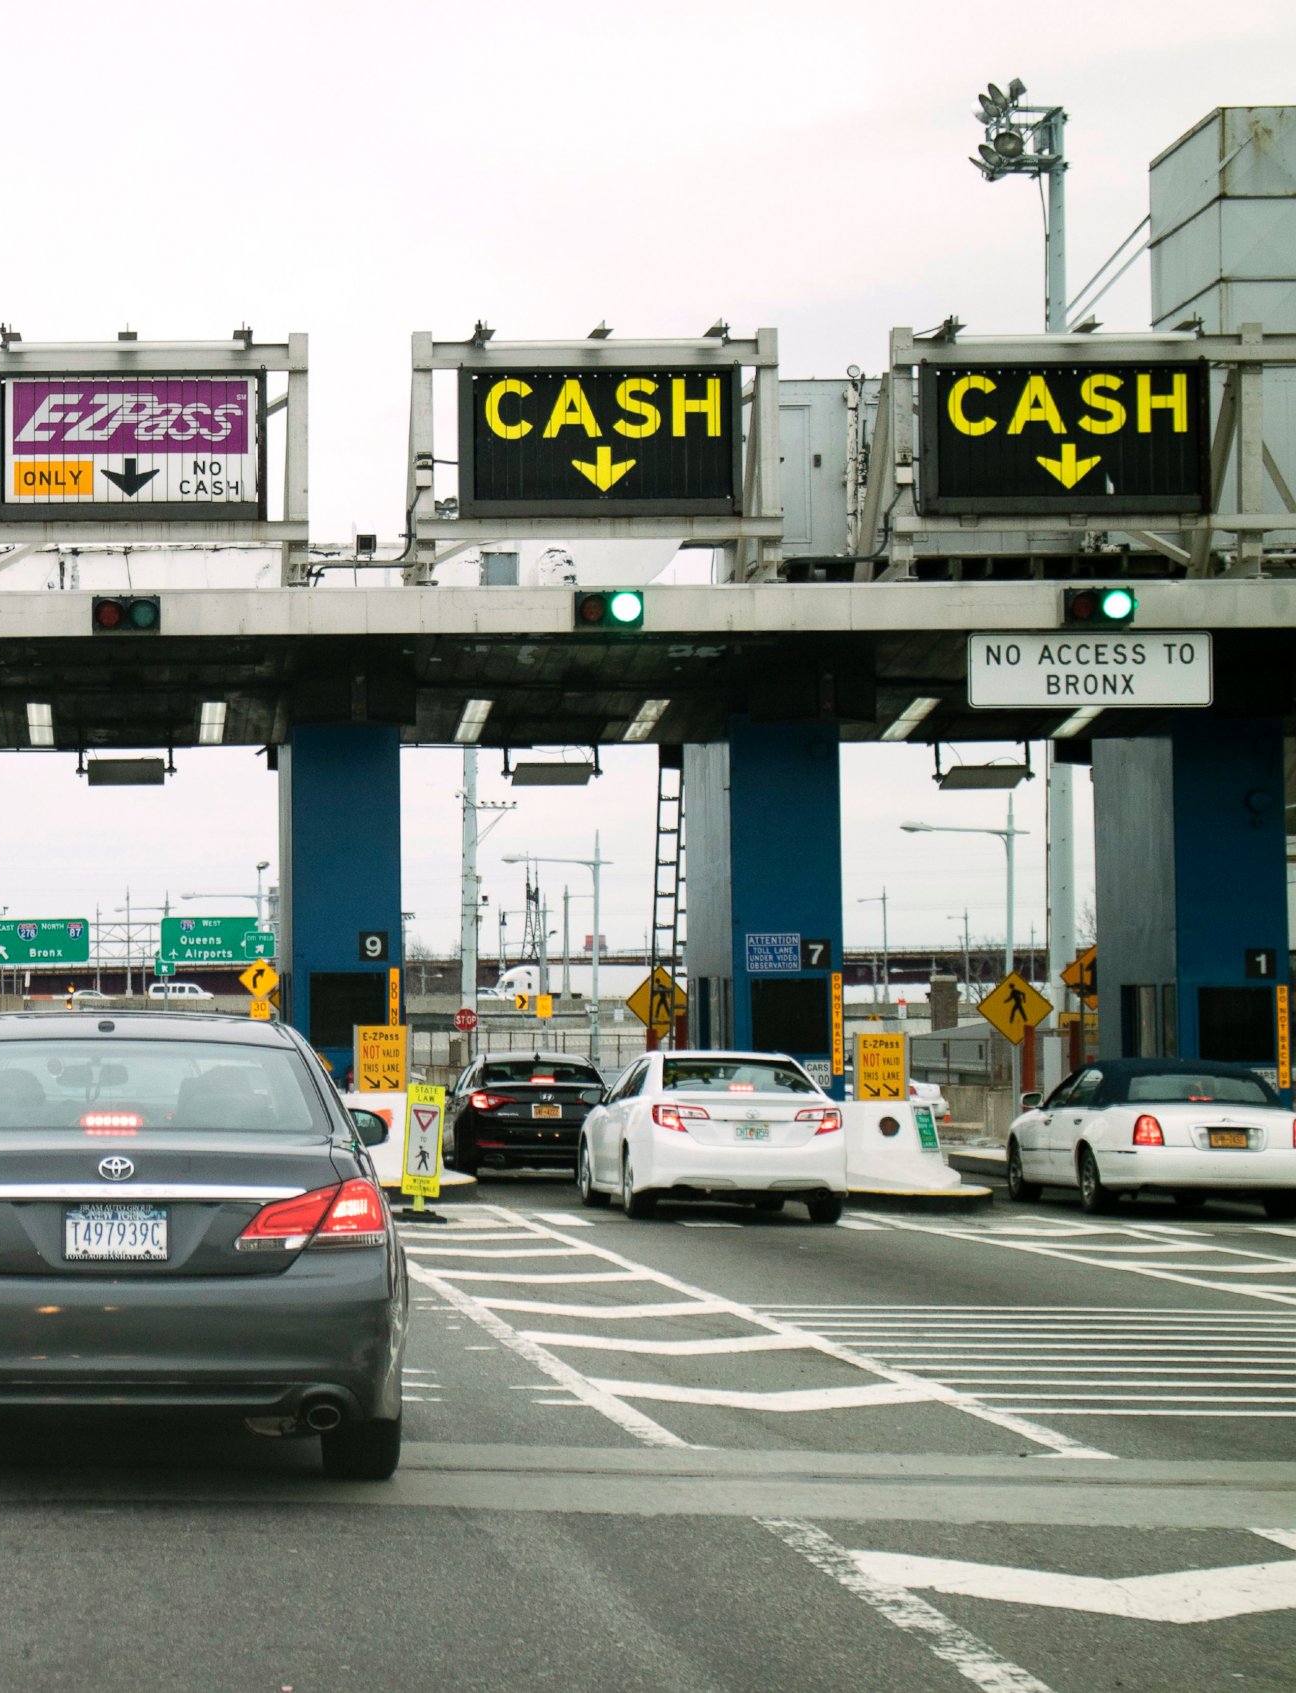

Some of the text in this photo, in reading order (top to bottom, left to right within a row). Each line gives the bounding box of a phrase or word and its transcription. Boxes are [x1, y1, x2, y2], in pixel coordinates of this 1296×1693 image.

[485, 377, 721, 440] CASH
[947, 373, 1188, 437] CASH
[14, 393, 243, 442] E-ZPass
[193, 460, 222, 476] NO
[23, 470, 82, 486] ONLY
[179, 480, 239, 495] CASH
[986, 642, 1196, 667] NO ACCESS TO
[1046, 673, 1135, 696] BRONX
[20, 928, 36, 938] 278
[69, 928, 81, 937] 87
[180, 935, 222, 945] Queens
[748, 936, 798, 945] ATTENTION
[29, 948, 63, 957] Bronx
[365, 936, 381, 957] 9
[774, 946, 793, 954] LANE
[185, 948, 233, 960] Airports
[808, 944, 824, 965] 7
[1255, 953, 1267, 974] 1
[834, 975, 840, 990] DO
[391, 982, 397, 999] DO
[254, 1002, 266, 1012] 30
[455, 1015, 477, 1025] STOP
[363, 1032, 399, 1041] E-ZPass
[863, 1040, 900, 1048] E-ZPass
[363, 1045, 399, 1059] NOT VALID
[864, 1053, 880, 1067] NOT
[364, 1064, 399, 1072] THIS LANE
[807, 1064, 829, 1072] CARS
[835, 1061, 841, 1073] UP
[864, 1072, 900, 1080] THIS LANE
[415, 1086, 438, 1094] STATE
[417, 1095, 435, 1103] LAW
[90, 1211, 144, 1220] NEW YORK
[71, 1222, 160, 1246] T497939C
